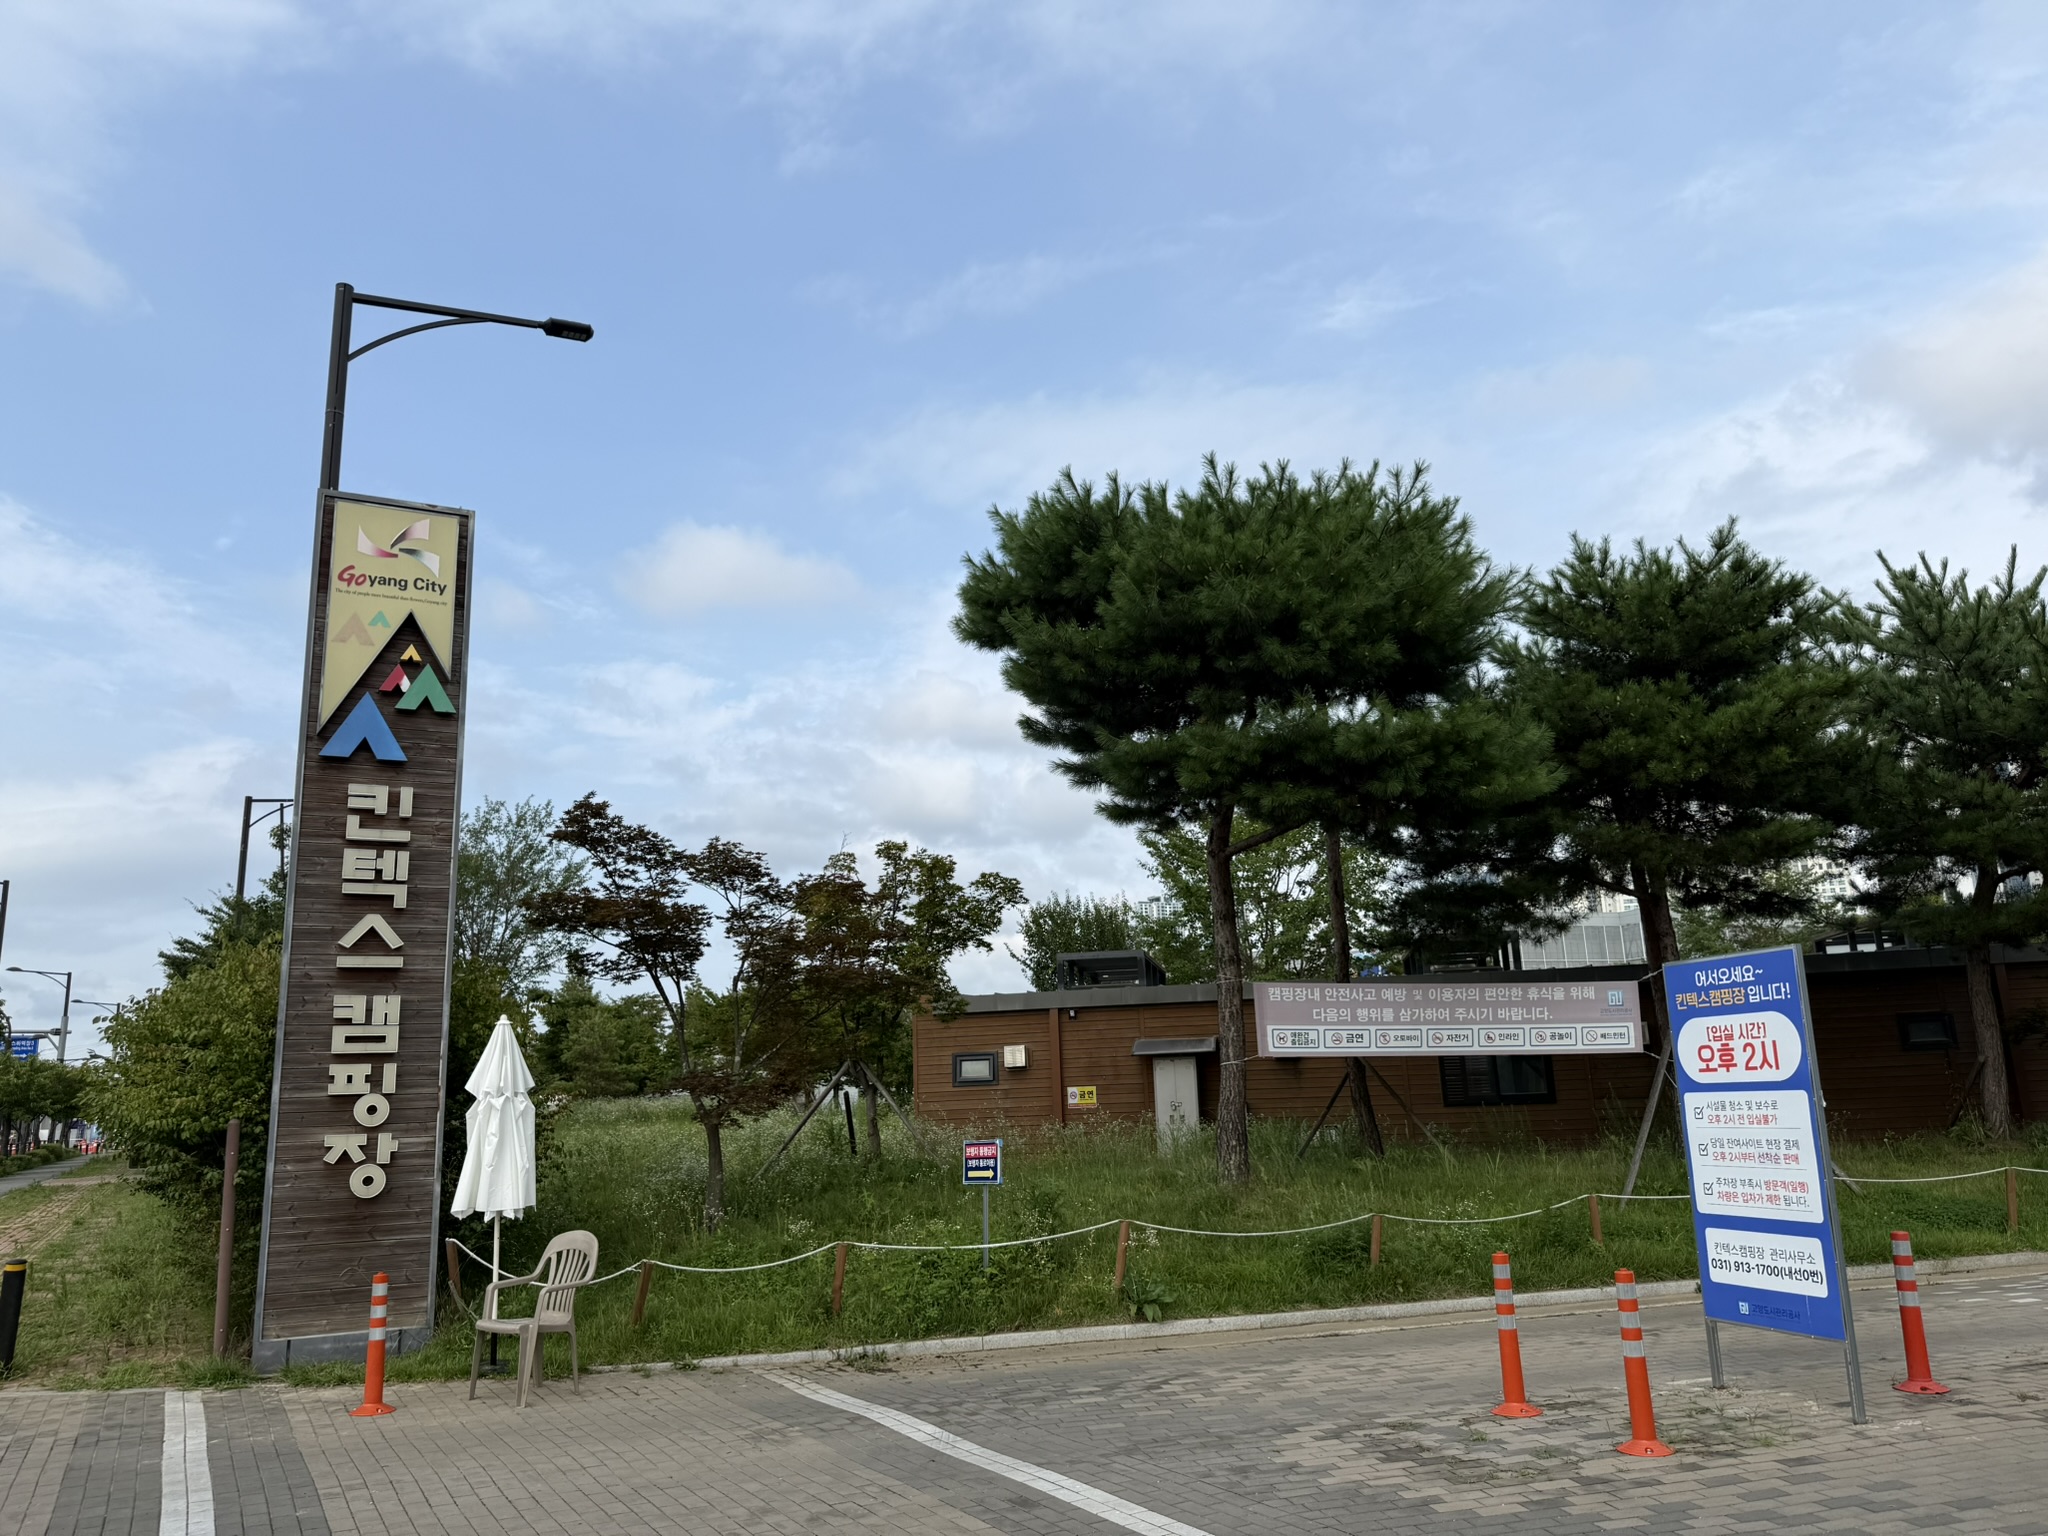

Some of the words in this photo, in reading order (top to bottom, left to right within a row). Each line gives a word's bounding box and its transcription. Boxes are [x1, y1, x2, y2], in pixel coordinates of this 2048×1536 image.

[338, 565, 408, 591] Goyang
[413, 577, 447, 596] City
[1695, 965, 1763, 987] 어서오세요~
[1268, 987, 1320, 1001] 캠핑장내
[1325, 987, 1377, 1001] 안전사고
[1381, 987, 1407, 1001] 예방
[1412, 989, 1423, 1001] 및
[1429, 987, 1479, 1001] 이용자의
[1484, 987, 1522, 1001] 편안한
[1527, 986, 1566, 1001] 휴식을
[1570, 986, 1595, 1000] 위해
[1675, 987, 1745, 1010] 킨텍스캠핑장
[1747, 982, 1791, 1003] 입니다!
[1313, 1008, 1351, 1022] 다음의
[1356, 1008, 1394, 1022] 행위를
[1399, 1008, 1450, 1022] 삼가하여
[1454, 1007, 1493, 1021] 주시기
[1497, 1007, 1553, 1021] 바랍니다.
[1345, 1033, 1364, 1043] 금연
[1393, 1034, 1419, 1042] 오토바이
[1446, 1034, 1469, 1042] 자전거
[1498, 1033, 1520, 1041] 인라인
[1549, 1032, 1572, 1041] 공놀이
[1706, 1024, 1734, 1042] [입실
[1738, 1022, 1767, 1040] 시간]
[1290, 1038, 1316, 1046] 출입금지
[1697, 1042, 1737, 1073] 오후
[1742, 1040, 1780, 1071] 2시
[1079, 1090, 1094, 1099] 금연
[1706, 1100, 1727, 1112] 시설물
[1729, 1100, 1744, 1112] 청소
[1745, 1100, 1753, 1111] 및
[1755, 1100, 1779, 1111] 보수로
[1707, 1114, 1721, 1125] 오후
[1723, 1114, 1736, 1125] 2시
[1737, 1114, 1745, 1125] 전
[1746, 1114, 1777, 1126] 입실불가
[1710, 1137, 1724, 1149] 당일
[1726, 1137, 1764, 1150] 잔여사이트
[1766, 1138, 1781, 1150] 현장
[1783, 1139, 1800, 1151] 결제
[1712, 1151, 1727, 1162] 오후
[1728, 1152, 1756, 1163] 2시부터
[1757, 1152, 1781, 1165] 선착순
[1783, 1153, 1800, 1165] 판매
[1715, 1177, 1738, 1189] 주차장
[1739, 1178, 1763, 1190] 부족시
[1763, 1179, 1809, 1194] 방문객(일행)
[1717, 1191, 1739, 1203] 차량은
[1741, 1192, 1764, 1204] 입차가
[1765, 1193, 1781, 1206] 제한
[1783, 1195, 1810, 1208] 됩니다.
[1714, 1242, 1765, 1260] 킨텍스캠핑장
[1769, 1248, 1816, 1265] 관리사무소
[1711, 1258, 1732, 1272] 031)
